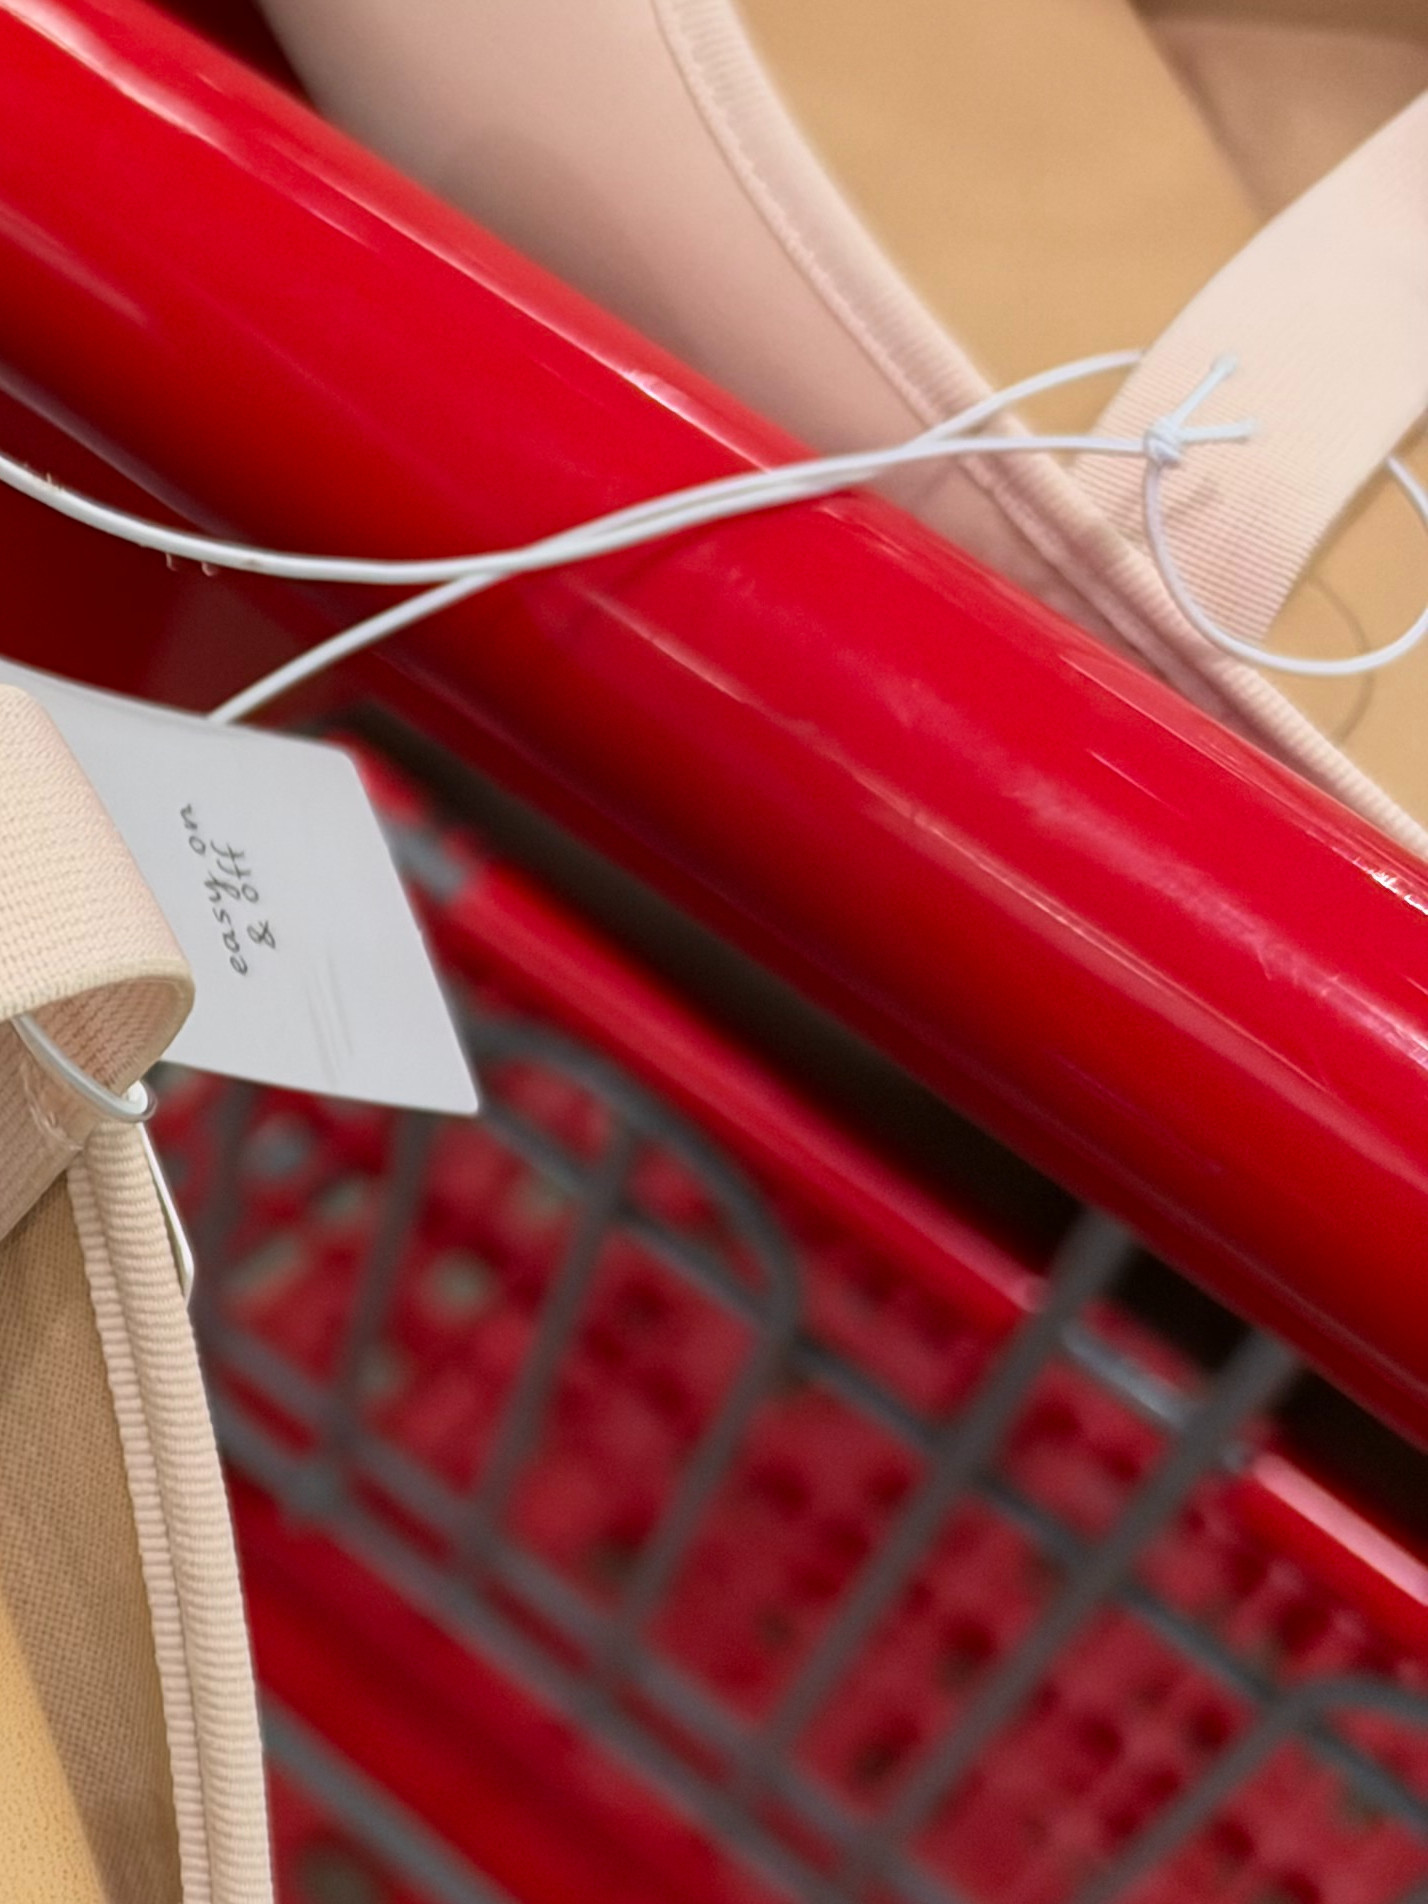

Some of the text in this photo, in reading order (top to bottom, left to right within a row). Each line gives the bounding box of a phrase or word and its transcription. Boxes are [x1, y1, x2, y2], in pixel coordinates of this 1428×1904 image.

[180, 803, 248, 976] easy on
[209, 839, 276, 950] & off
